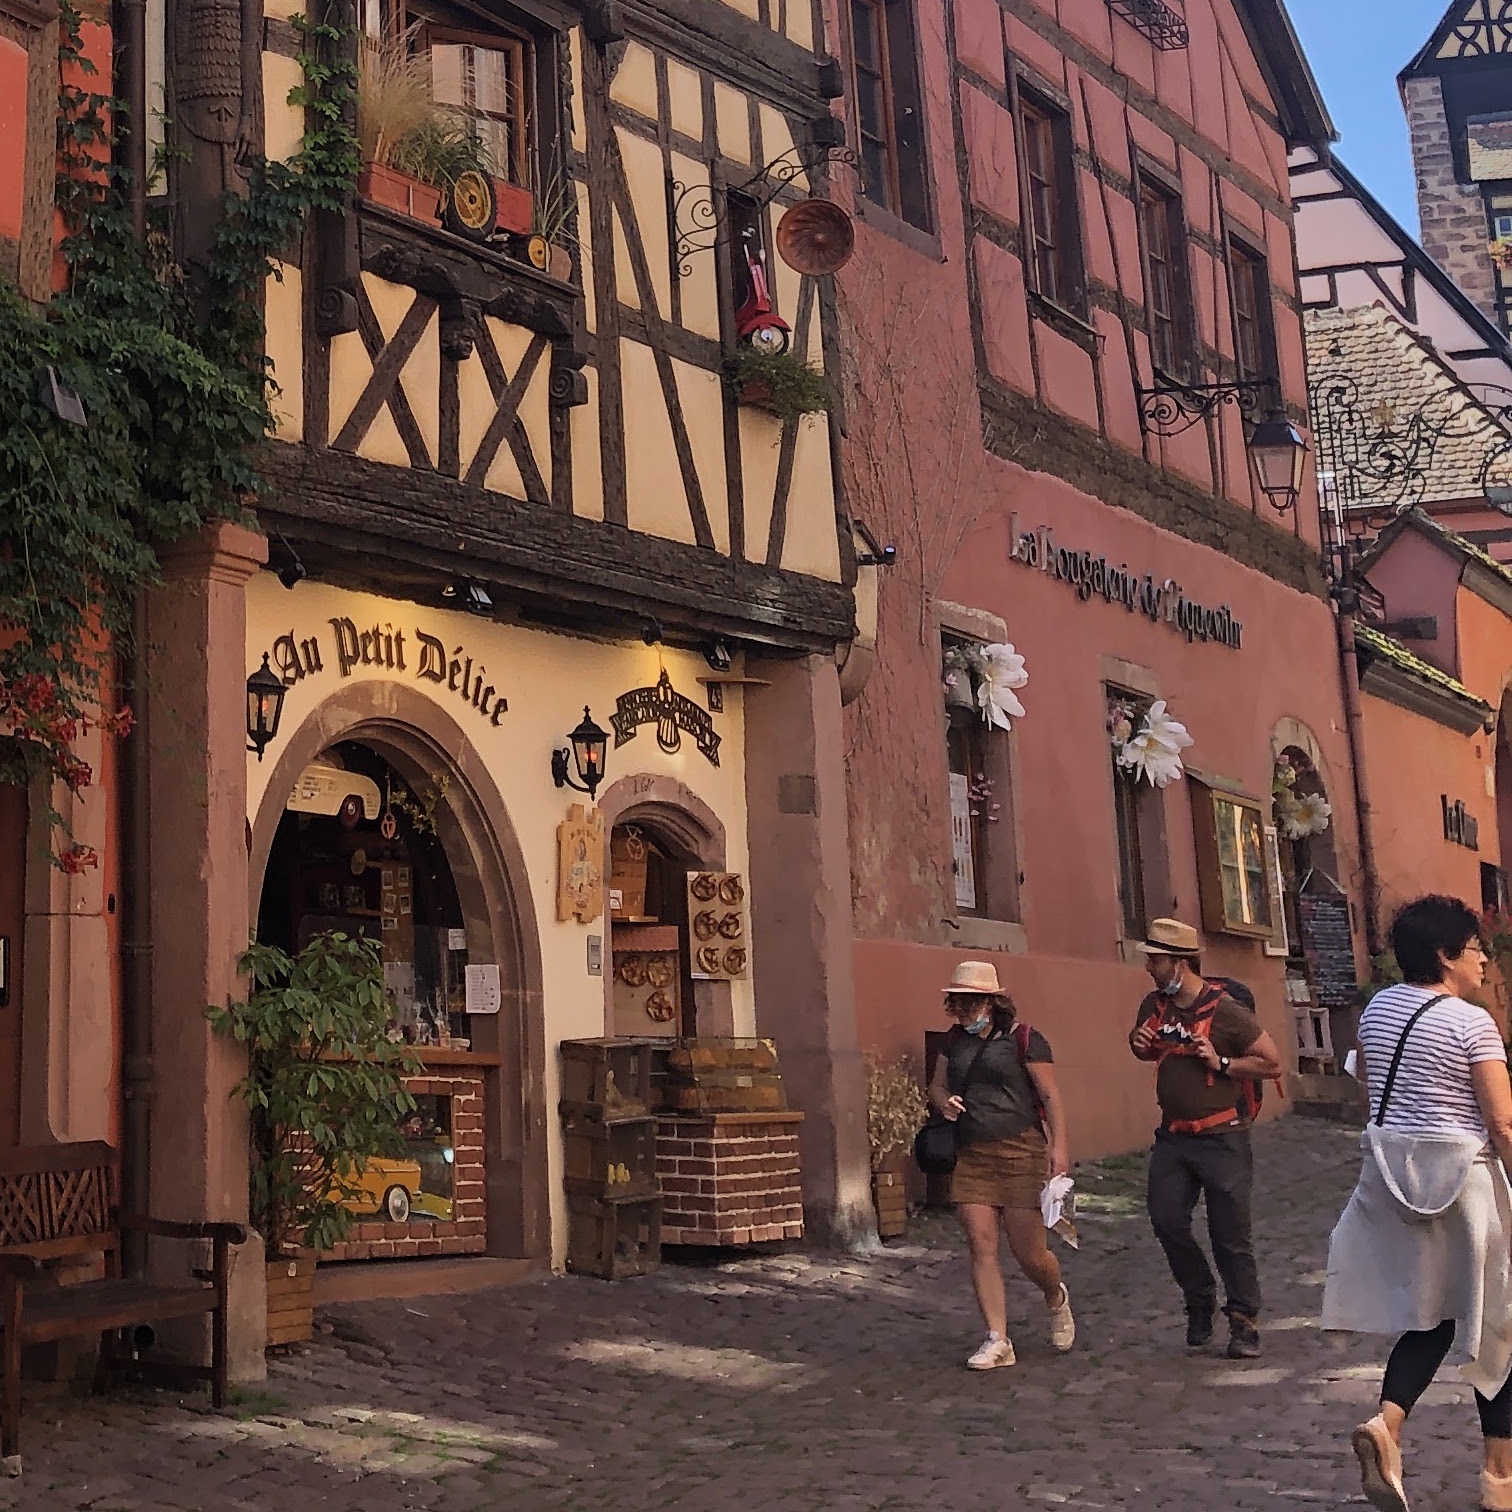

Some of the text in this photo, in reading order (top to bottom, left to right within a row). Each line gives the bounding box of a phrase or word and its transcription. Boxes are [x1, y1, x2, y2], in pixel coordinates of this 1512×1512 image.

[272, 616, 510, 727] Au Petit Délice
